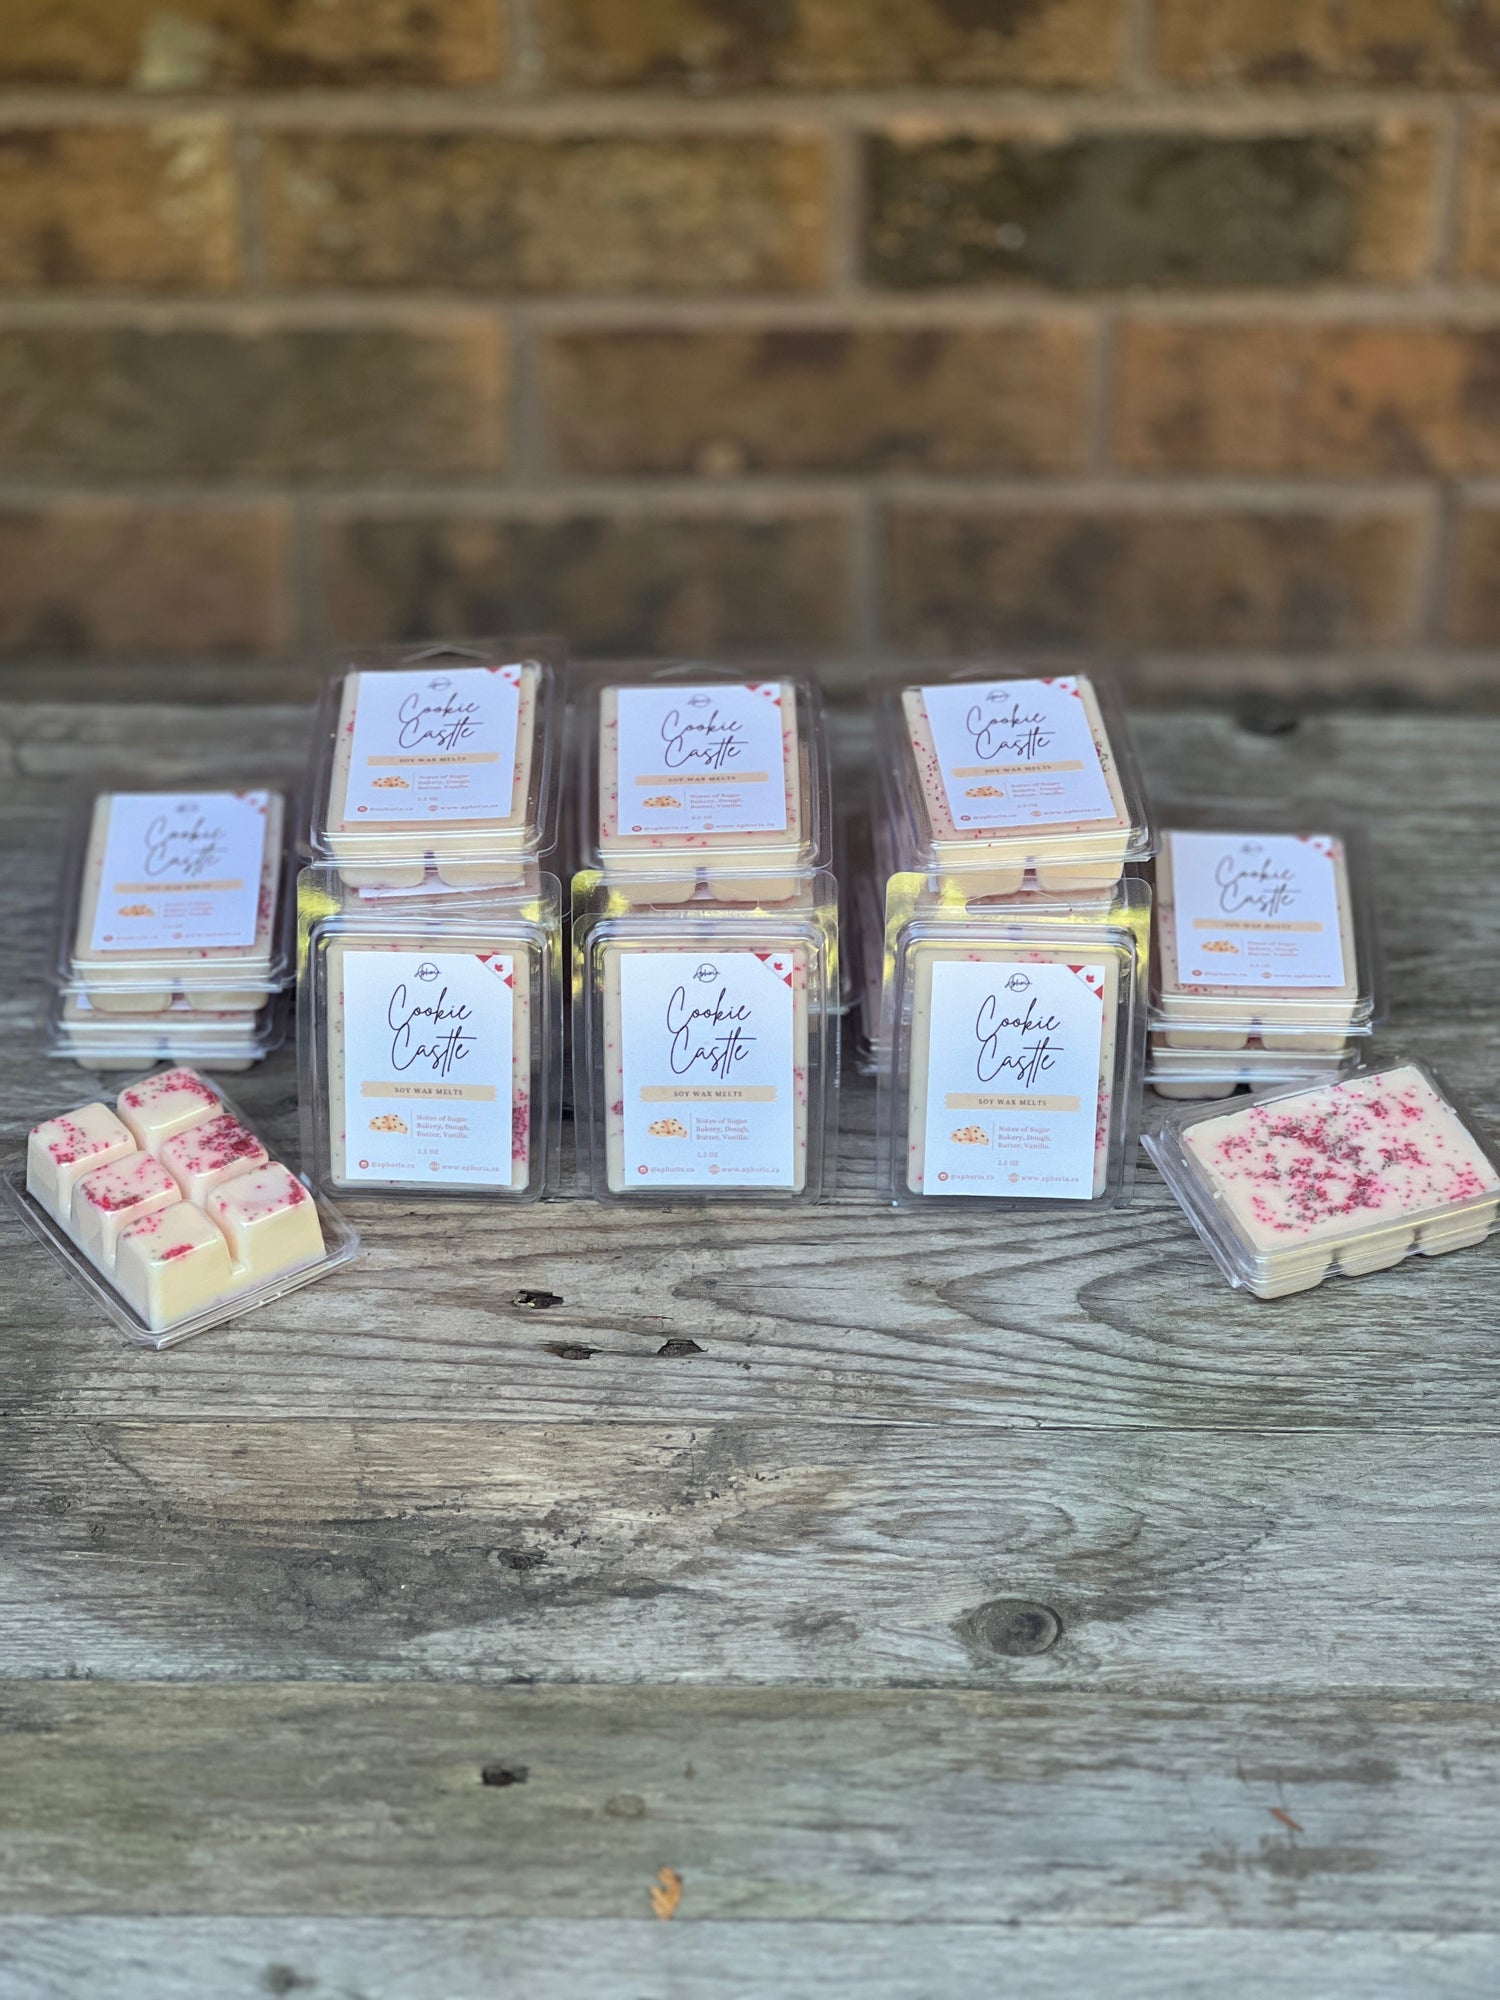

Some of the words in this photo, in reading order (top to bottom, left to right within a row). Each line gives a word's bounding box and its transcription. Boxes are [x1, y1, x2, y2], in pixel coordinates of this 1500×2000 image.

[399, 692, 480, 724] Cookie
[661, 709, 743, 742] Cookie
[967, 703, 1047, 736] Cookie
[398, 716, 484, 751] Castle
[976, 726, 1057, 760] Castle
[665, 735, 749, 770] Castle
[1215, 855, 1295, 887] Cookie
[1220, 882, 1302, 917] Castle
[388, 984, 472, 1031] Cookie
[667, 986, 751, 1034] Cookie
[976, 994, 1061, 1042] Cookie
[391, 1022, 477, 1077] Castle
[670, 1025, 757, 1080] Castle
[977, 1033, 1065, 1088] Castle
[395, 1087, 412, 1095] SOY
[413, 1087, 433, 1095] WAX
[435, 1088, 464, 1096] MELTS
[673, 1090, 690, 1098] SOY
[692, 1090, 712, 1098] WAX
[714, 1090, 743, 1098] MELTS
